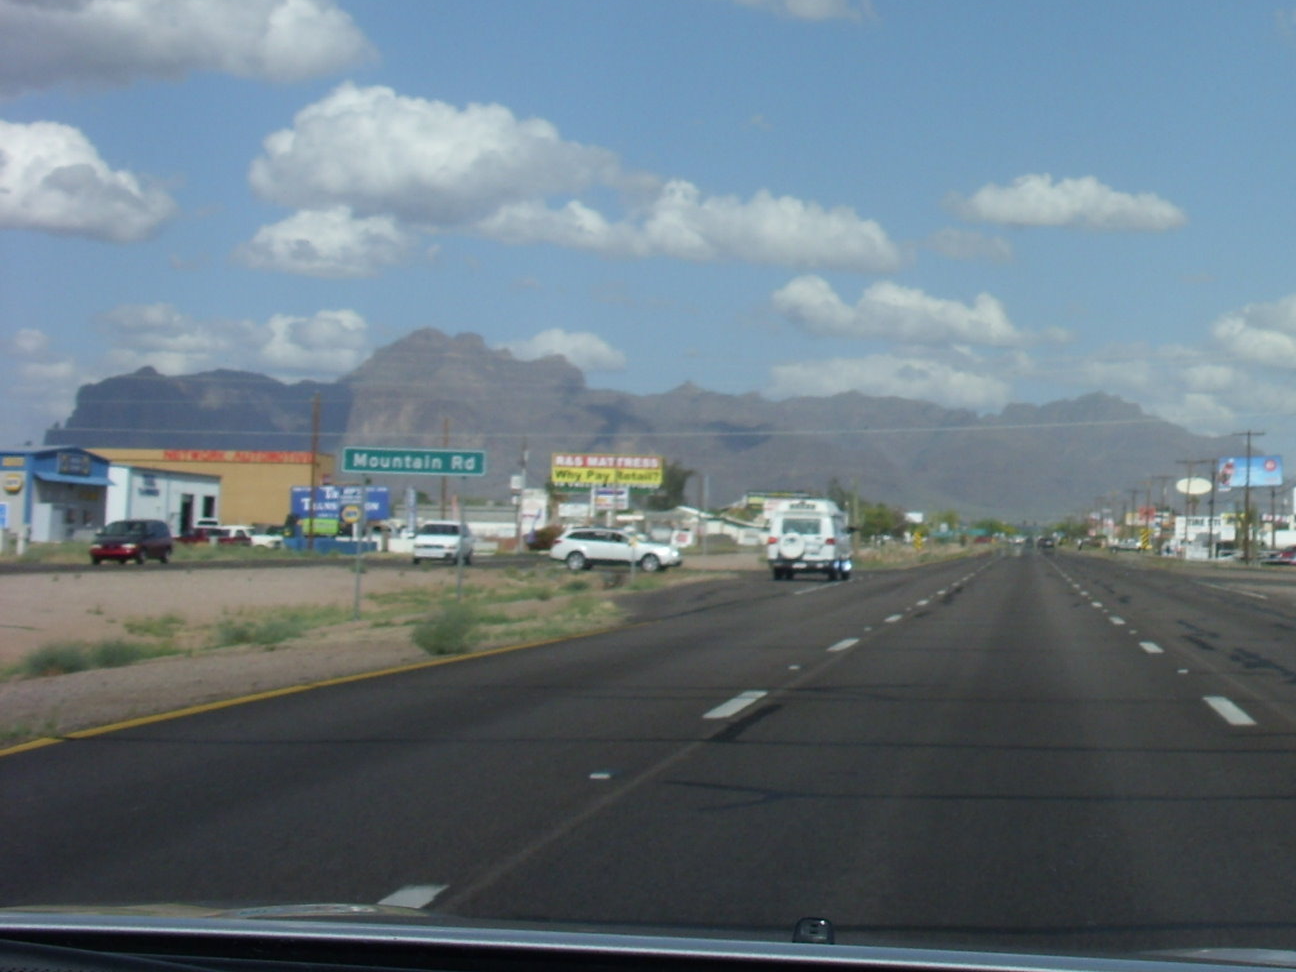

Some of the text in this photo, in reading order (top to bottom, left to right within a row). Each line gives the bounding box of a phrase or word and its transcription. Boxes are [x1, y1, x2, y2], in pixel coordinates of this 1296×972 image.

[353, 453, 476, 470] Mountain Rd
[587, 456, 658, 467] MATTRESS
[555, 471, 582, 482] Why
[586, 470, 610, 486] Pay
